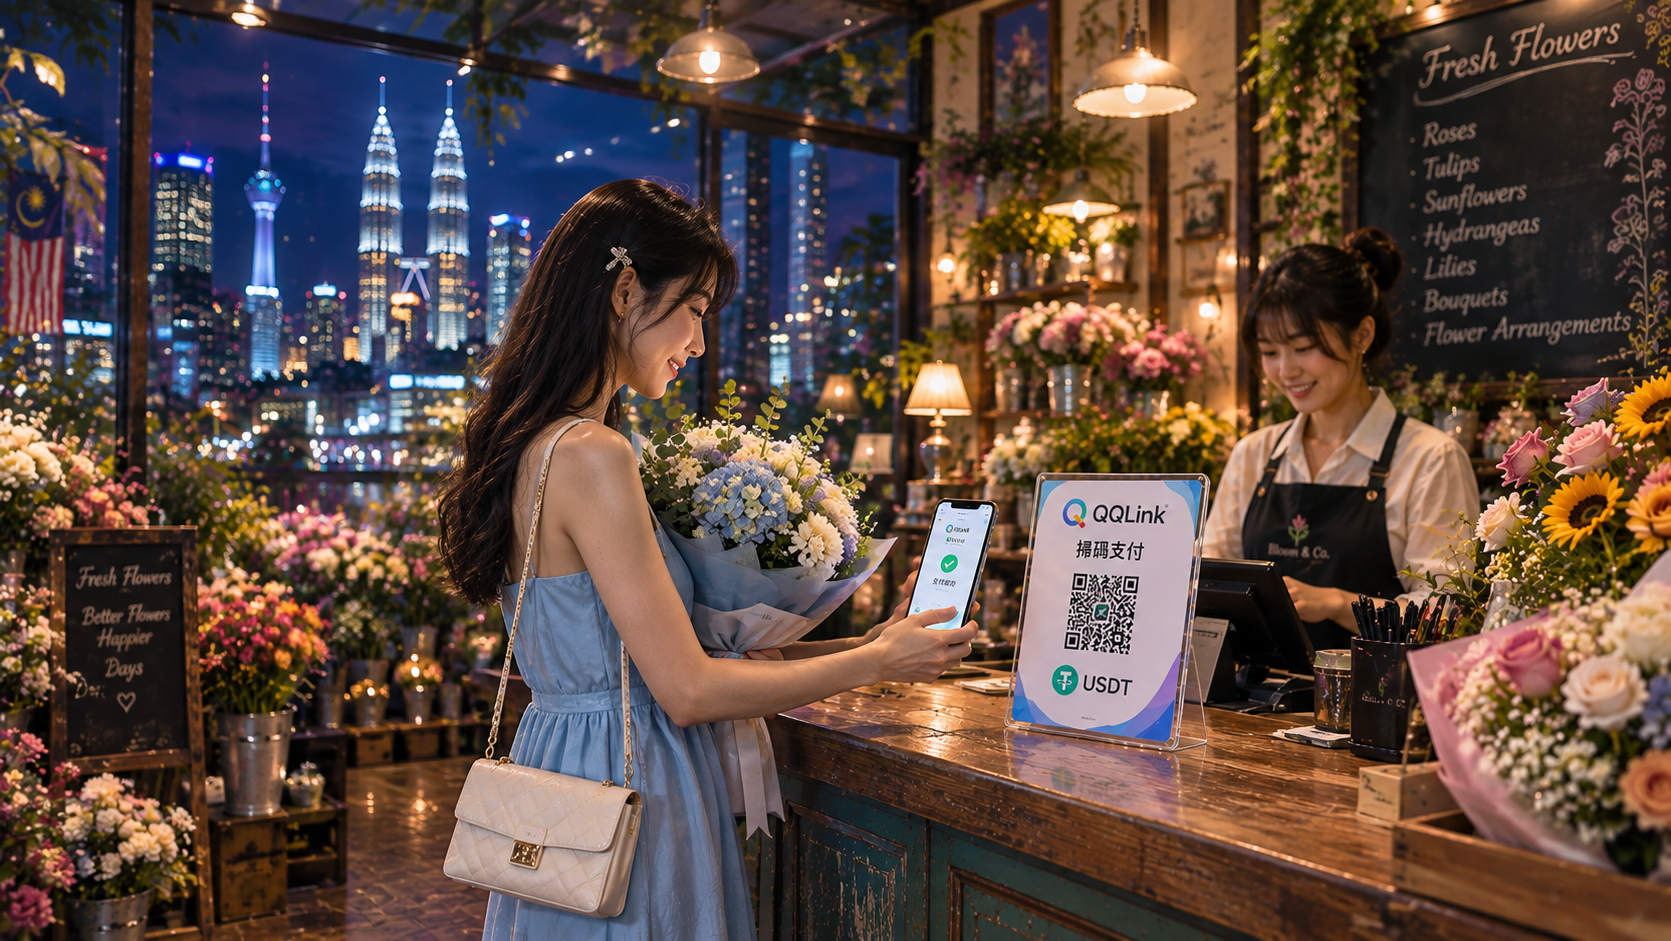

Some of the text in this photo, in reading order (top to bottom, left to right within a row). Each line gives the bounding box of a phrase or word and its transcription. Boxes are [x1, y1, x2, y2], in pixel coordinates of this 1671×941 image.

[1418, 22, 1621, 89] Fresh Flowers
[1422, 121, 1477, 148] Roses
[1423, 152, 1480, 182] Tulips
[1422, 183, 1528, 215] Sunflowers
[1423, 217, 1540, 252] Hydrangeas
[1423, 254, 1477, 281] Lilies
[1423, 286, 1509, 316] Bouquets
[1423, 311, 1632, 347] Flower Arrangements
[1093, 504, 1166, 525] QQLink
[1268, 542, 1330, 559] Bloom & Co.
[76, 564, 172, 590] Fresh Flowers
[82, 603, 171, 626] Better Flowers
[97, 627, 153, 652] Happier
[105, 657, 144, 683] Days
[1083, 674, 1133, 696] USDT
